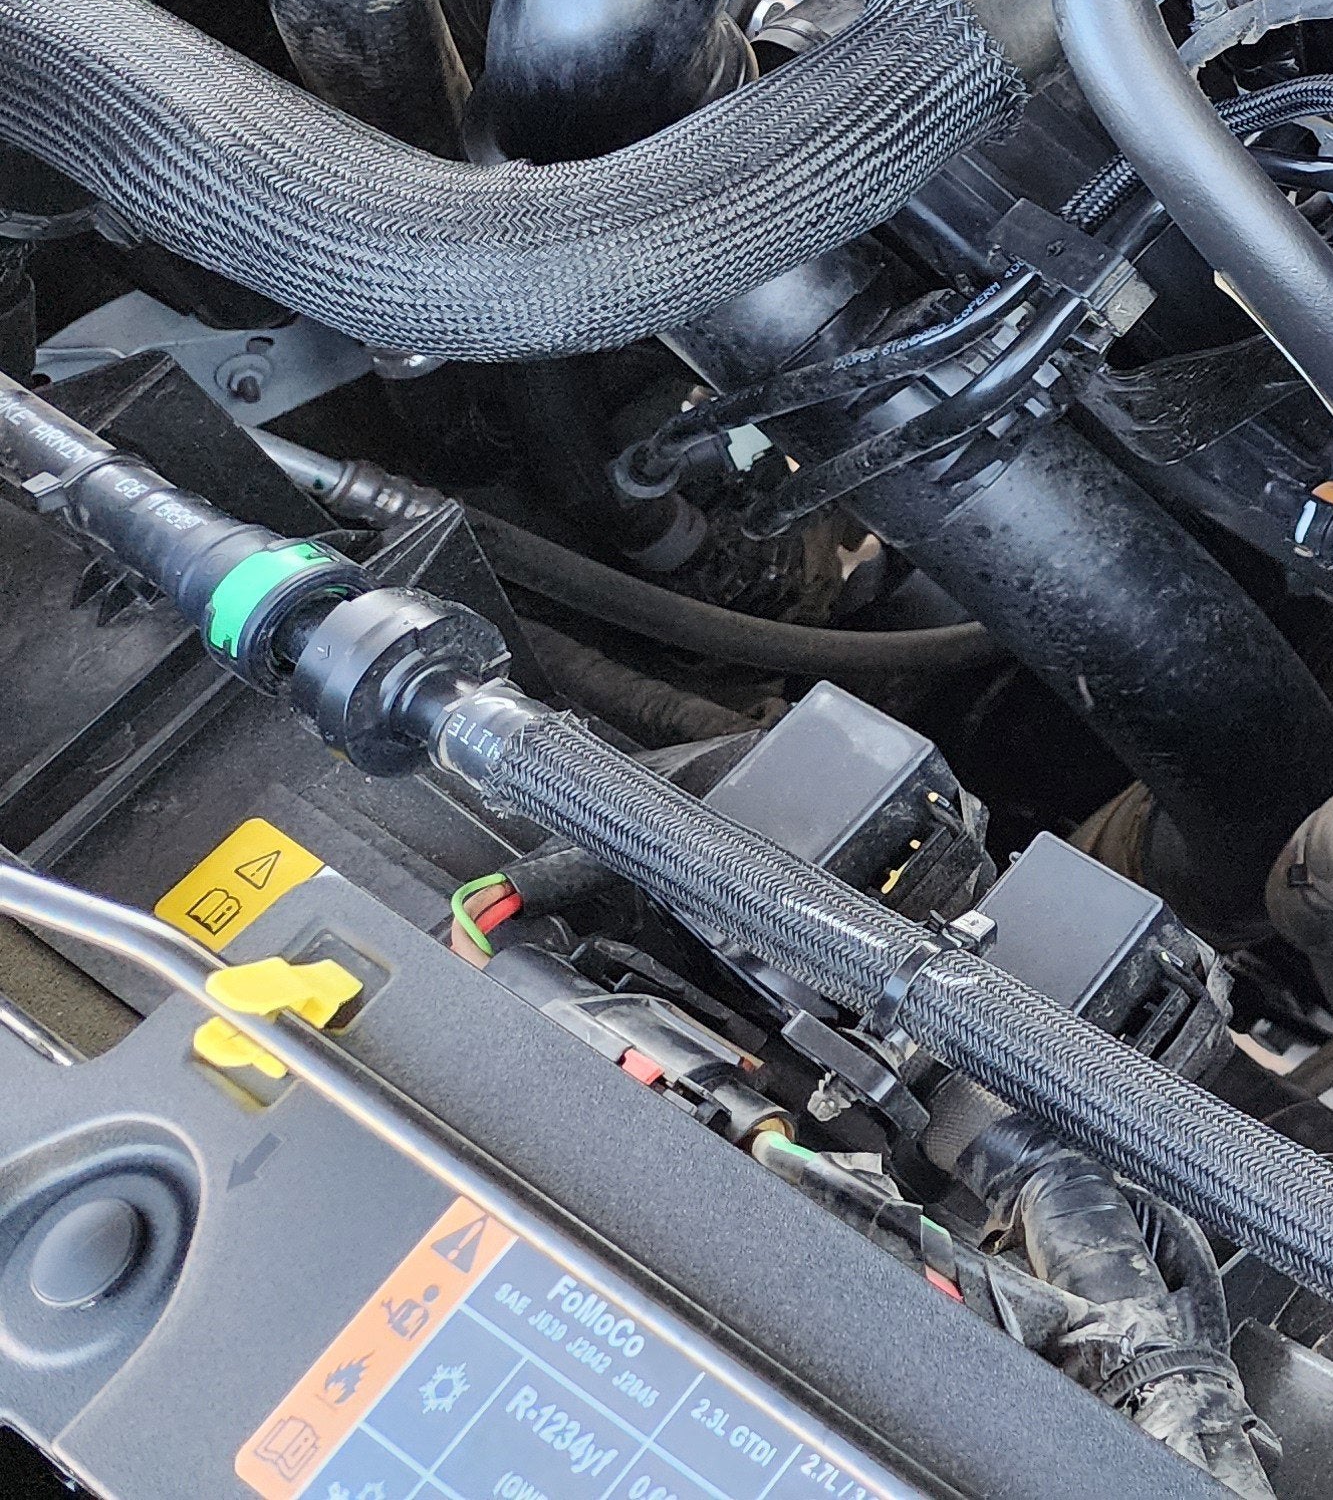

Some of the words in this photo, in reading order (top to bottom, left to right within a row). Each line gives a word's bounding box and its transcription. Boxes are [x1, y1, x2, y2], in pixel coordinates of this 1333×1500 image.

[113, 477, 150, 500] GB
[493, 1281, 533, 1317] SAE
[545, 1273, 646, 1360] FoMoCo
[504, 1382, 619, 1479] R-1234yf
[688, 1397, 729, 1438] 2.3L
[728, 1425, 780, 1470] GTDI
[799, 1451, 838, 1494] 2.7L
